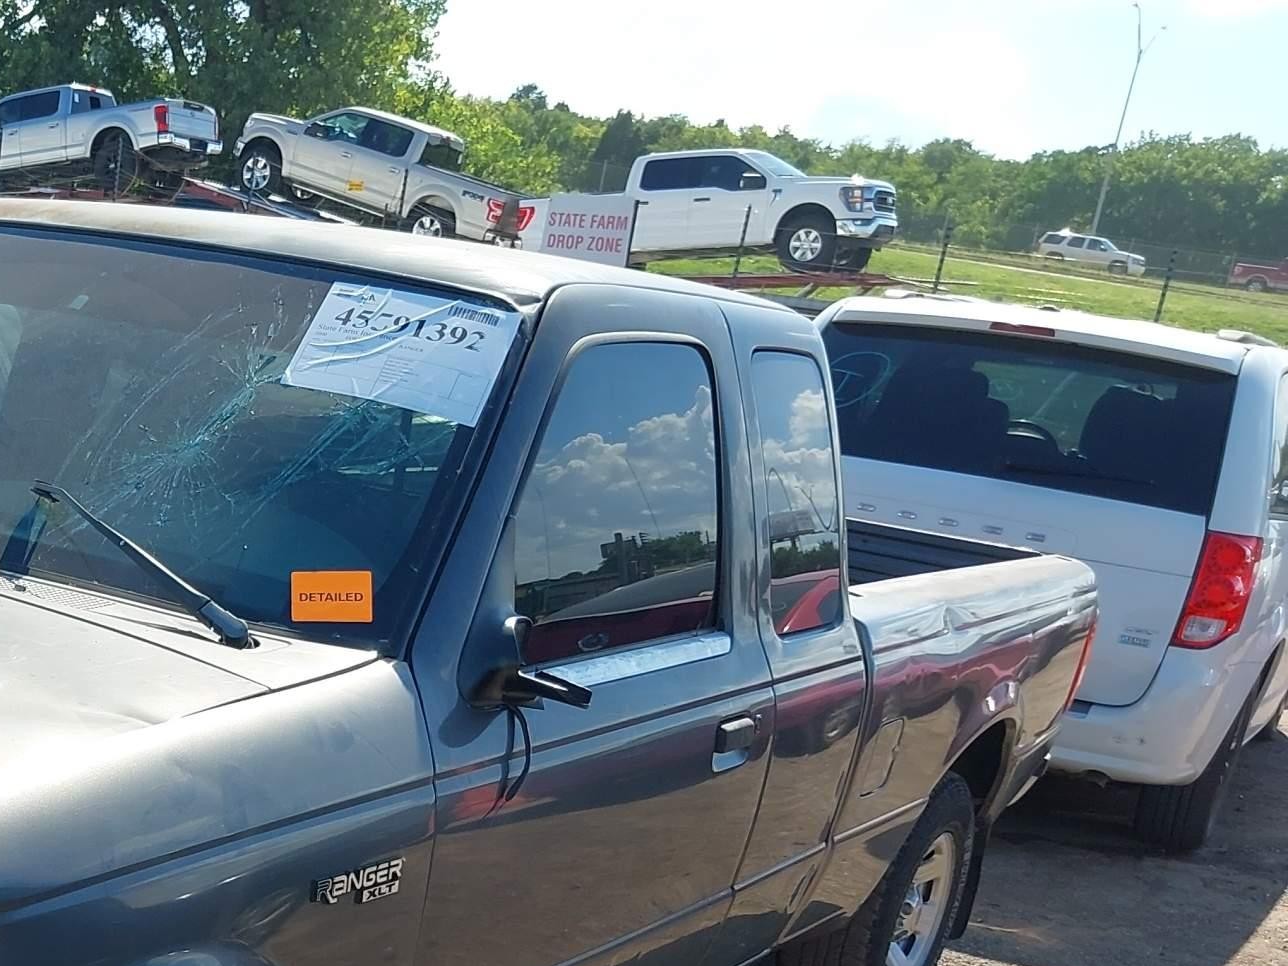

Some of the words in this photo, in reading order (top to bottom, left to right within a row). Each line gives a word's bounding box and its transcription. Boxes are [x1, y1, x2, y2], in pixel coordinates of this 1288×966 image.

[548, 211, 586, 229] STATE
[589, 214, 629, 231] FARM
[546, 233, 584, 250] DROP
[586, 236, 624, 253] ZONE
[334, 306, 488, 353] 45591392
[299, 592, 364, 602] DETAILED
[365, 882, 397, 901] XLT
